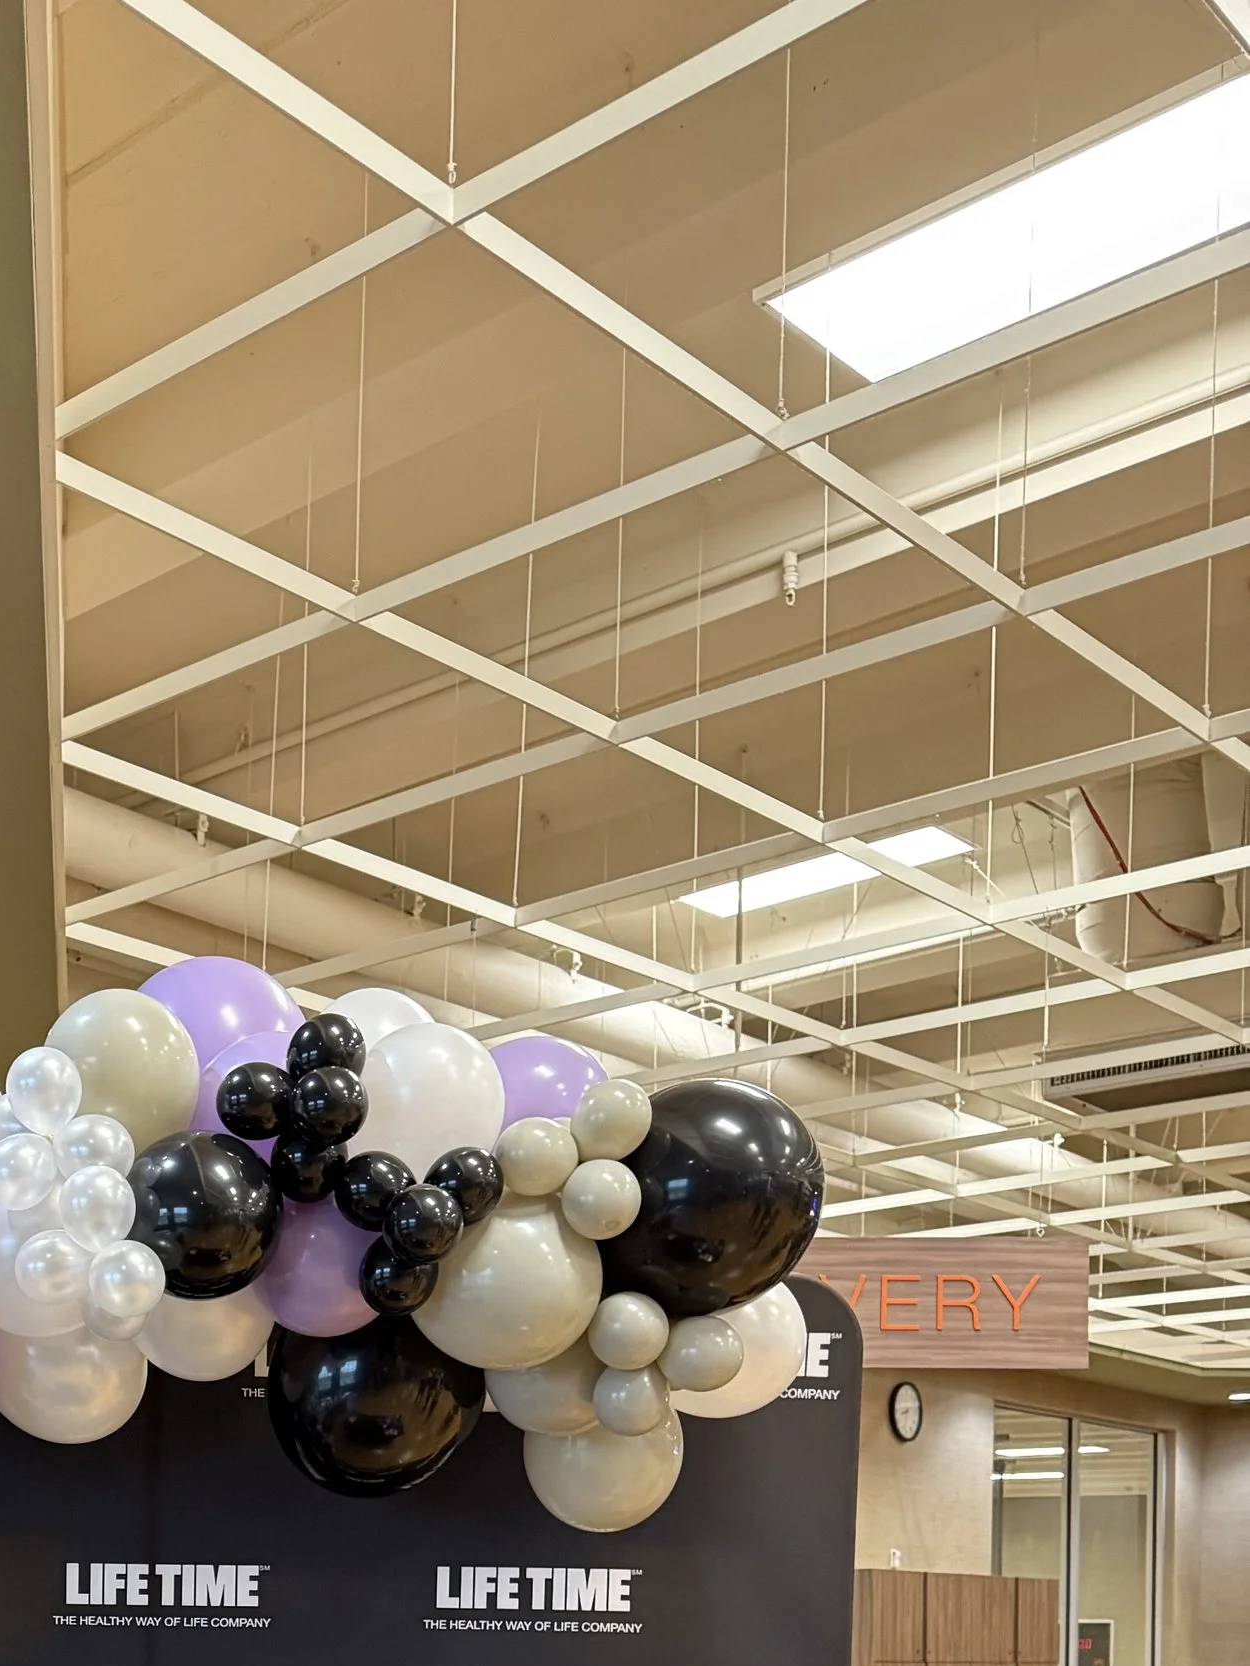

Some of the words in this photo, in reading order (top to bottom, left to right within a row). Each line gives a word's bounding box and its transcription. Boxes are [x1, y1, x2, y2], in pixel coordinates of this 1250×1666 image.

[241, 1387, 266, 1398] THE
[66, 1563, 149, 1605] LIFE
[156, 1564, 259, 1606] TIME
[437, 1567, 519, 1609] LIFE
[526, 1568, 631, 1612] TIME
[52, 1615, 77, 1626] THE
[79, 1615, 133, 1626] HEALTHY
[135, 1616, 162, 1627] WAY
[164, 1616, 182, 1627] OF
[183, 1617, 209, 1628] LIFE
[210, 1617, 272, 1628] COMPANY
[422, 1619, 447, 1630] THE
[449, 1619, 504, 1631] HEALTHY
[505, 1620, 533, 1631] WAY
[534, 1620, 552, 1632] OF
[553, 1621, 580, 1632] LIFE
[581, 1621, 643, 1634] COMPANY
